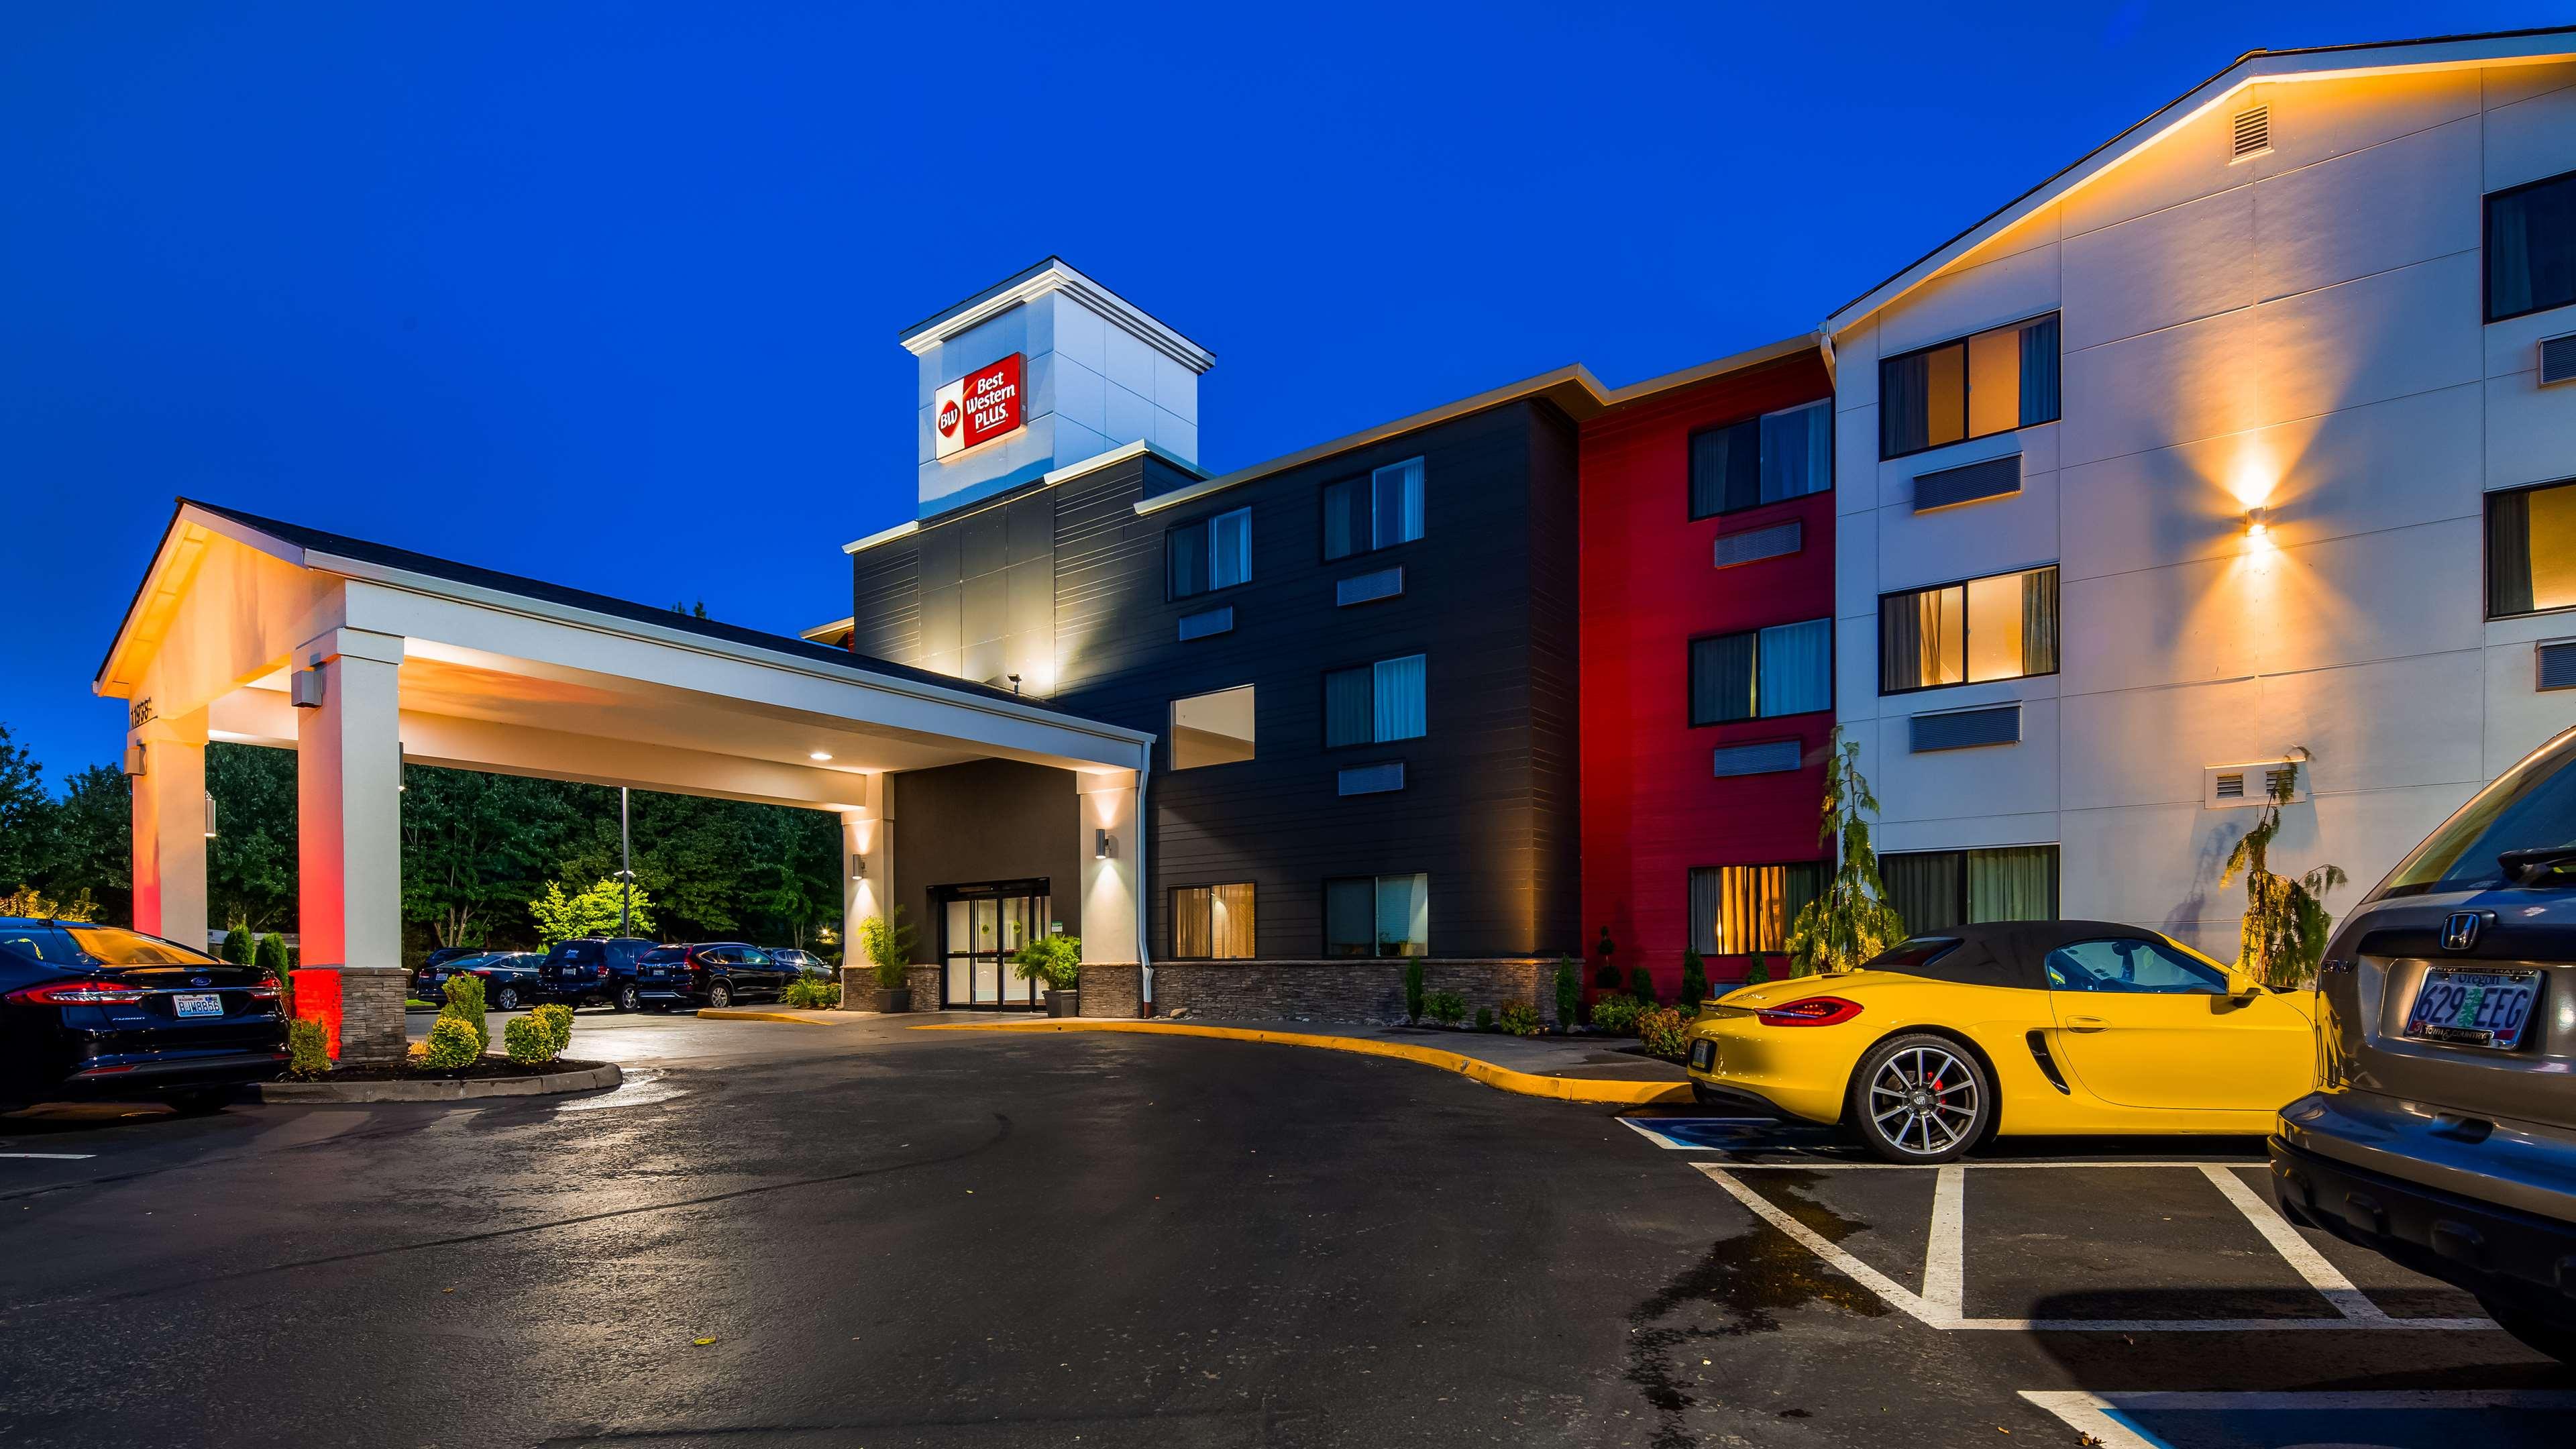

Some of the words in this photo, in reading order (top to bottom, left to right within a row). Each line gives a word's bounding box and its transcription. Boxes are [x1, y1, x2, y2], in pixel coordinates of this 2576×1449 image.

[977, 372, 1004, 394] Best
[966, 384, 1016, 415] Western
[941, 409, 958, 429] BW
[2458, 974, 2500, 987] Oregon
[178, 1002, 220, 1013] BJW8856
[2416, 985, 2467, 1024] 629
[2473, 987, 2528, 1028] EEG
